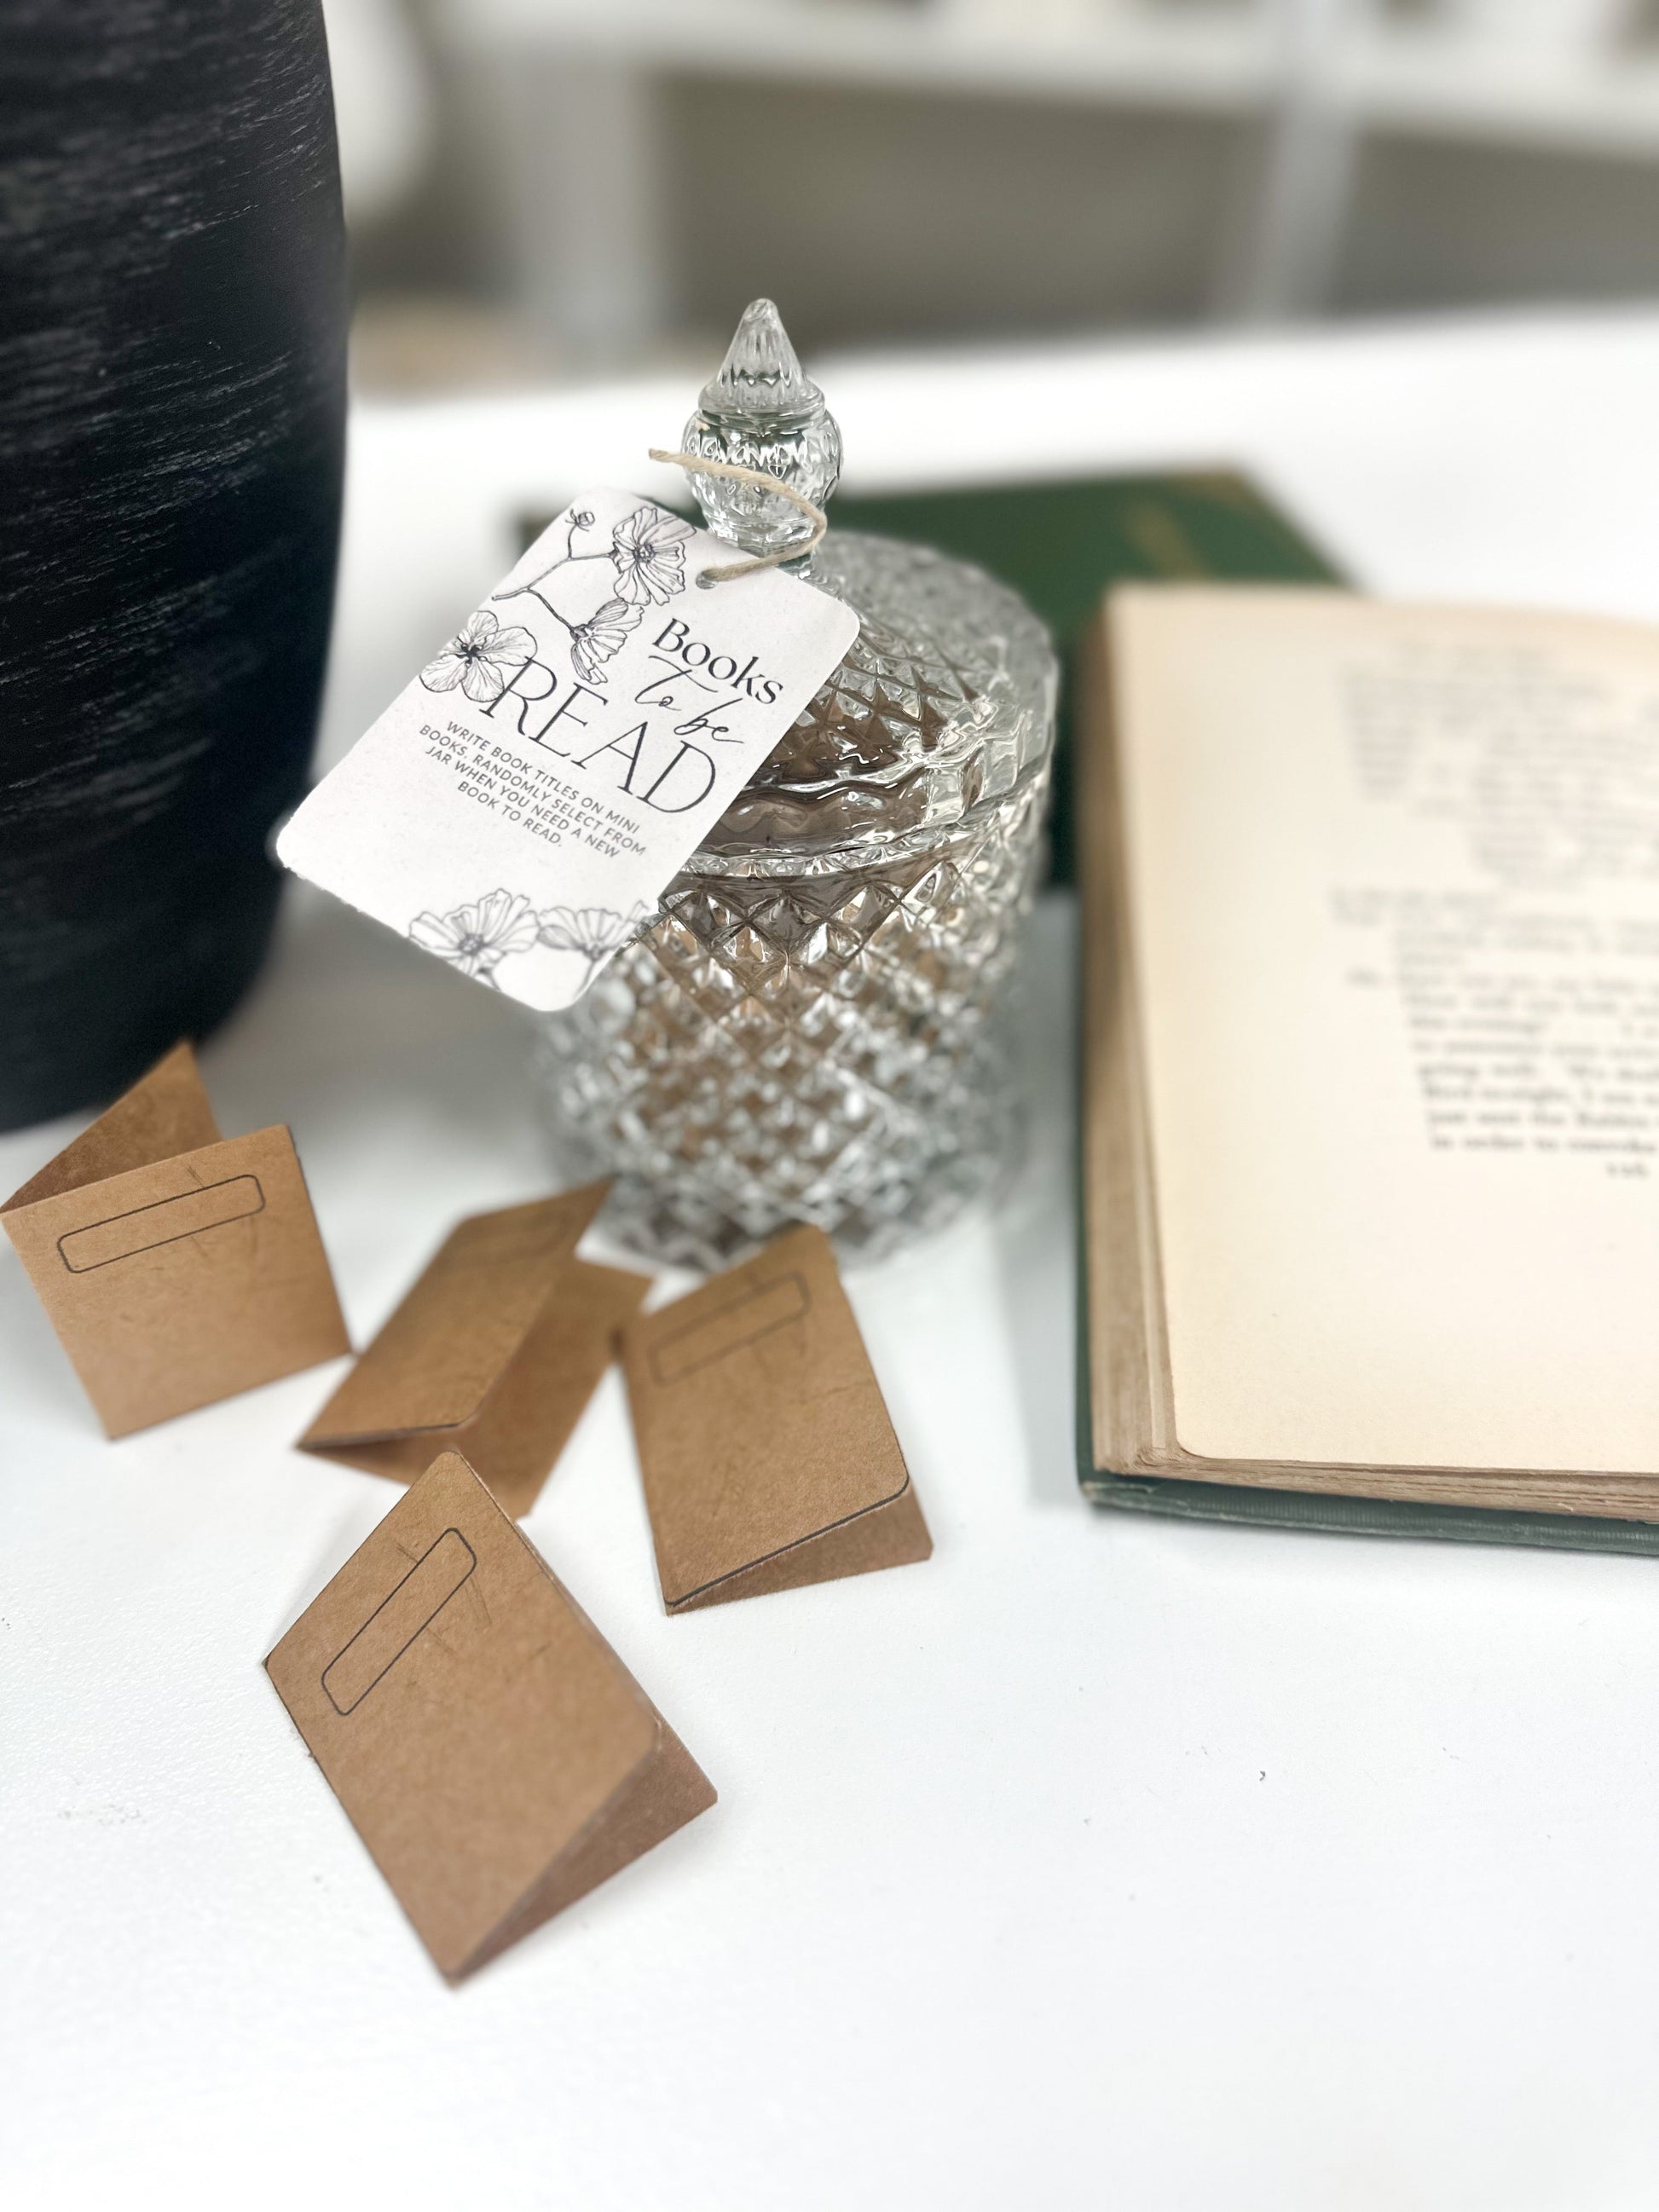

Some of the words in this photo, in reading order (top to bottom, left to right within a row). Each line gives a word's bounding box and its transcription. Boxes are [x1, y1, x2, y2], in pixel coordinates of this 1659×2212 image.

[652, 617, 783, 705] Books
[478, 656, 716, 813] READ
[673, 697, 745, 744] be
[425, 747, 452, 765] JAR
[454, 760, 497, 789] WHEN
[500, 785, 529, 808] YOU
[530, 804, 569, 830] NEED
[569, 828, 582, 839] A
[584, 834, 621, 858] NEW
[447, 721, 491, 751] WRITE
[490, 746, 533, 774] BOOK
[535, 770, 580, 800] TITLES
[581, 797, 604, 814] ON
[605, 810, 640, 835] MINI
[457, 781, 500, 809] BOOK
[501, 805, 522, 822] TO
[523, 817, 563, 847] READ.
[472, 754, 552, 802] RANDOMLY
[551, 799, 603, 831] SELECT
[604, 828, 646, 856] FROM
